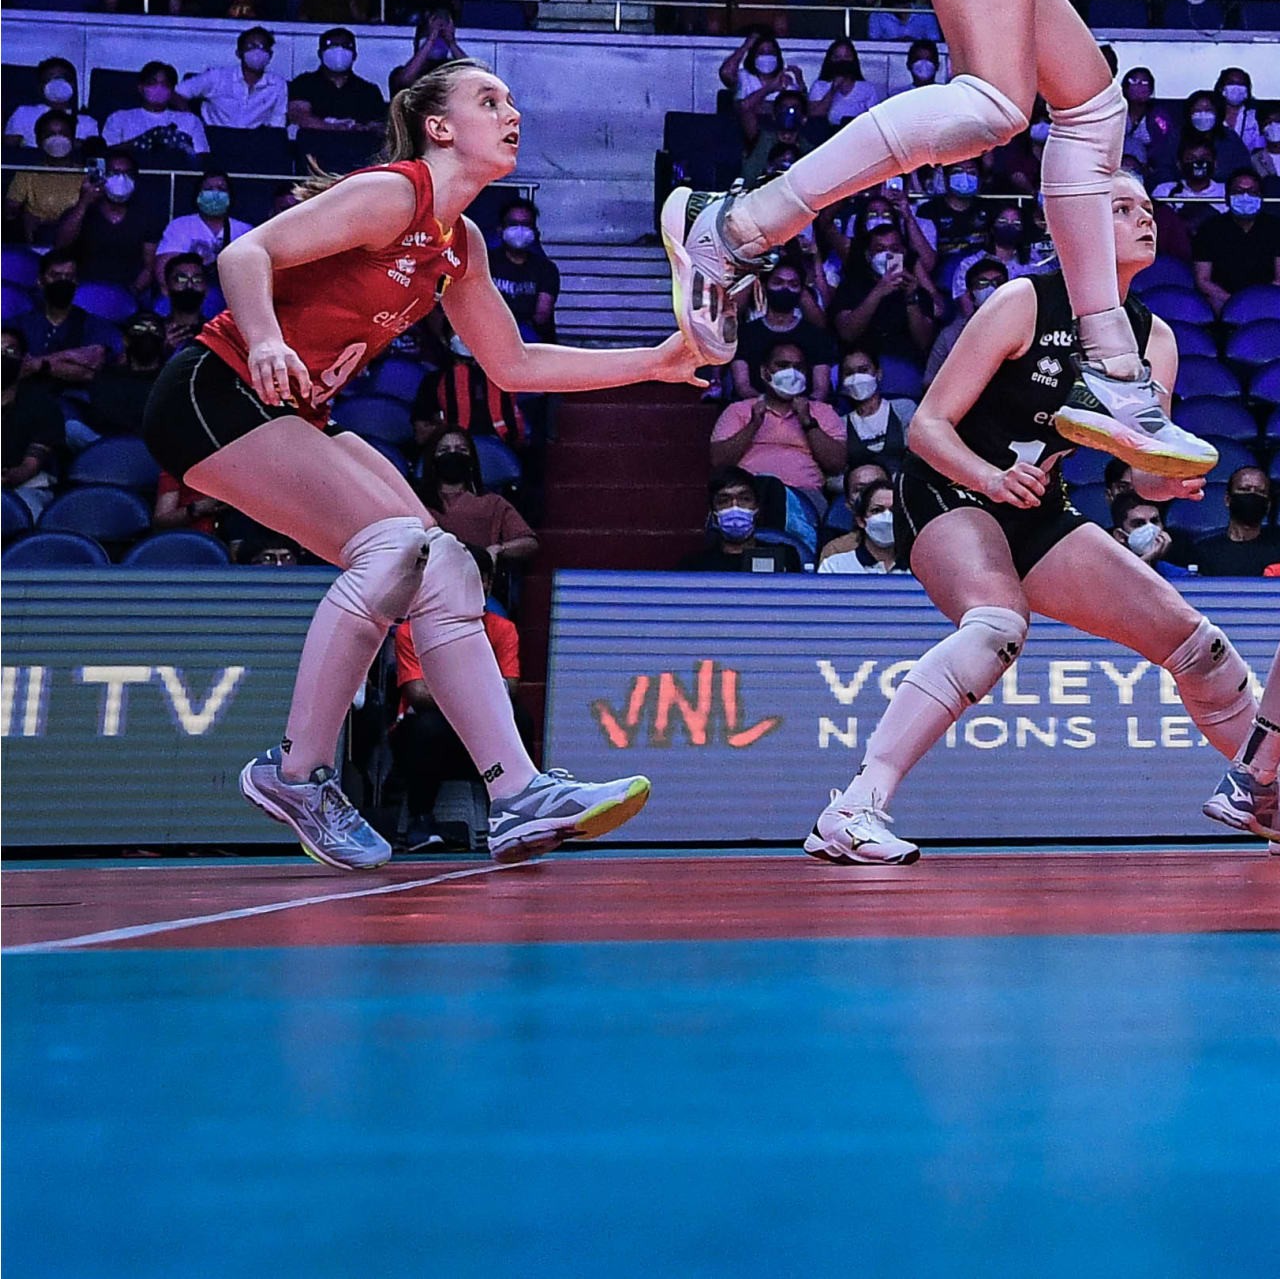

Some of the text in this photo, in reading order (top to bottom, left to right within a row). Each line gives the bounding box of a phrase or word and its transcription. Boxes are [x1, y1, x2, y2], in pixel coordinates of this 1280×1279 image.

[1031, 371, 1059, 388] errea
[82, 665, 246, 736] TV
[590, 658, 783, 749] VNL
[818, 716, 1097, 749] NIONS
